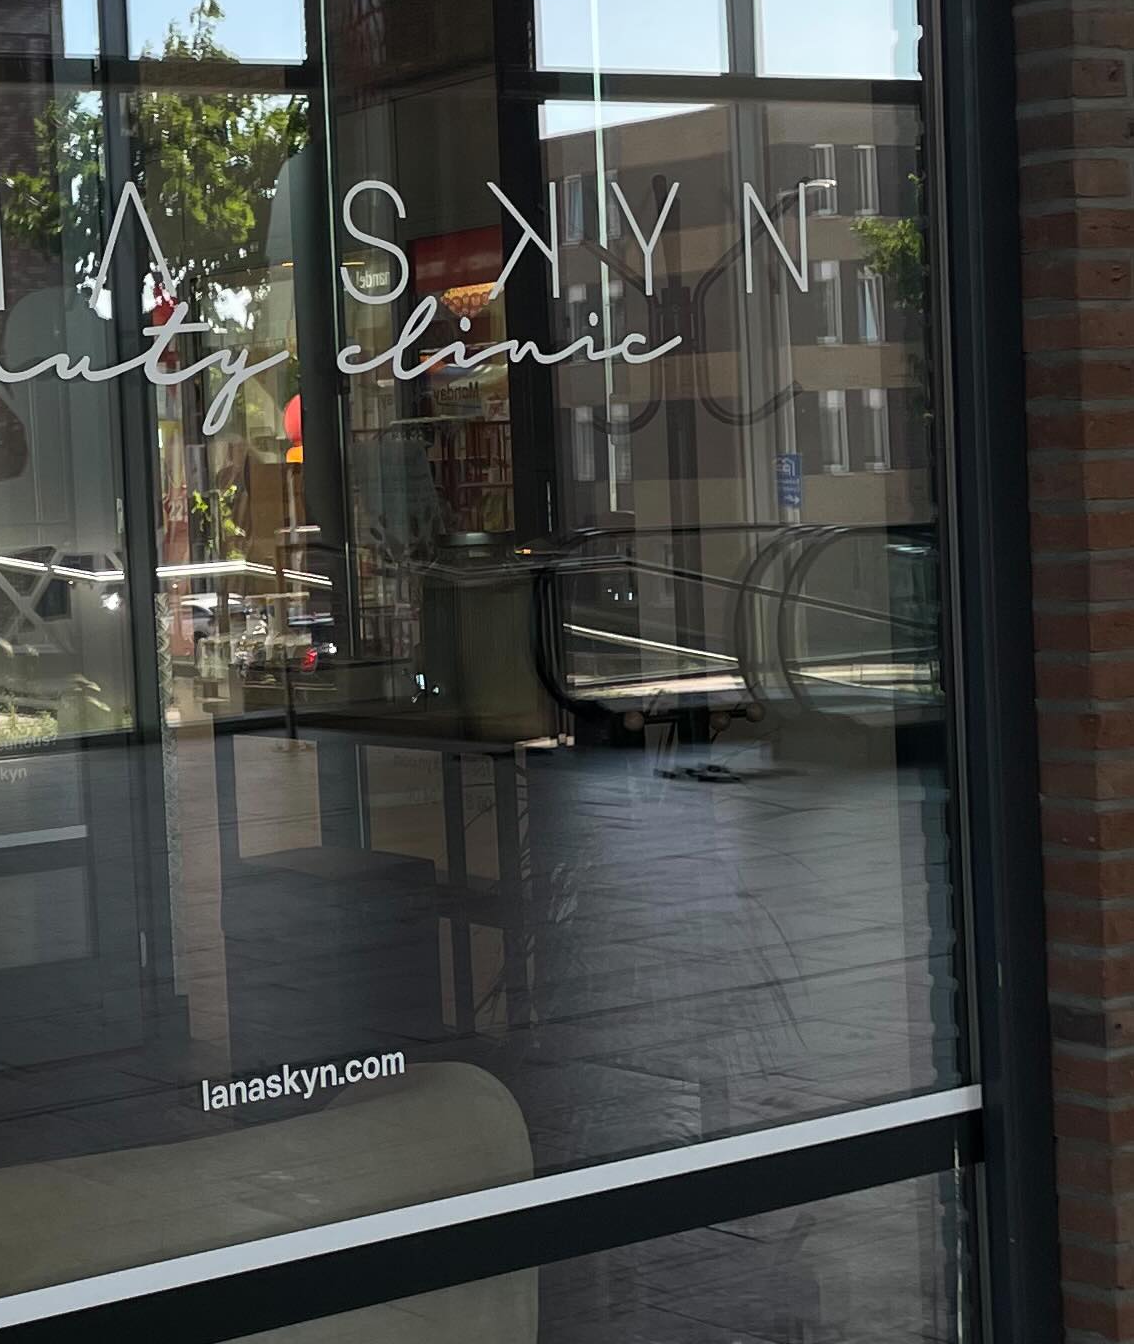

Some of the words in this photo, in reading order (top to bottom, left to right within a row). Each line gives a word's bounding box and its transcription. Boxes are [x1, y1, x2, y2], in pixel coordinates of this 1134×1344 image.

[339, 179, 810, 305] SKYN
[335, 295, 683, 381] clinic
[201, 1051, 406, 1112] lanaskyn.com
